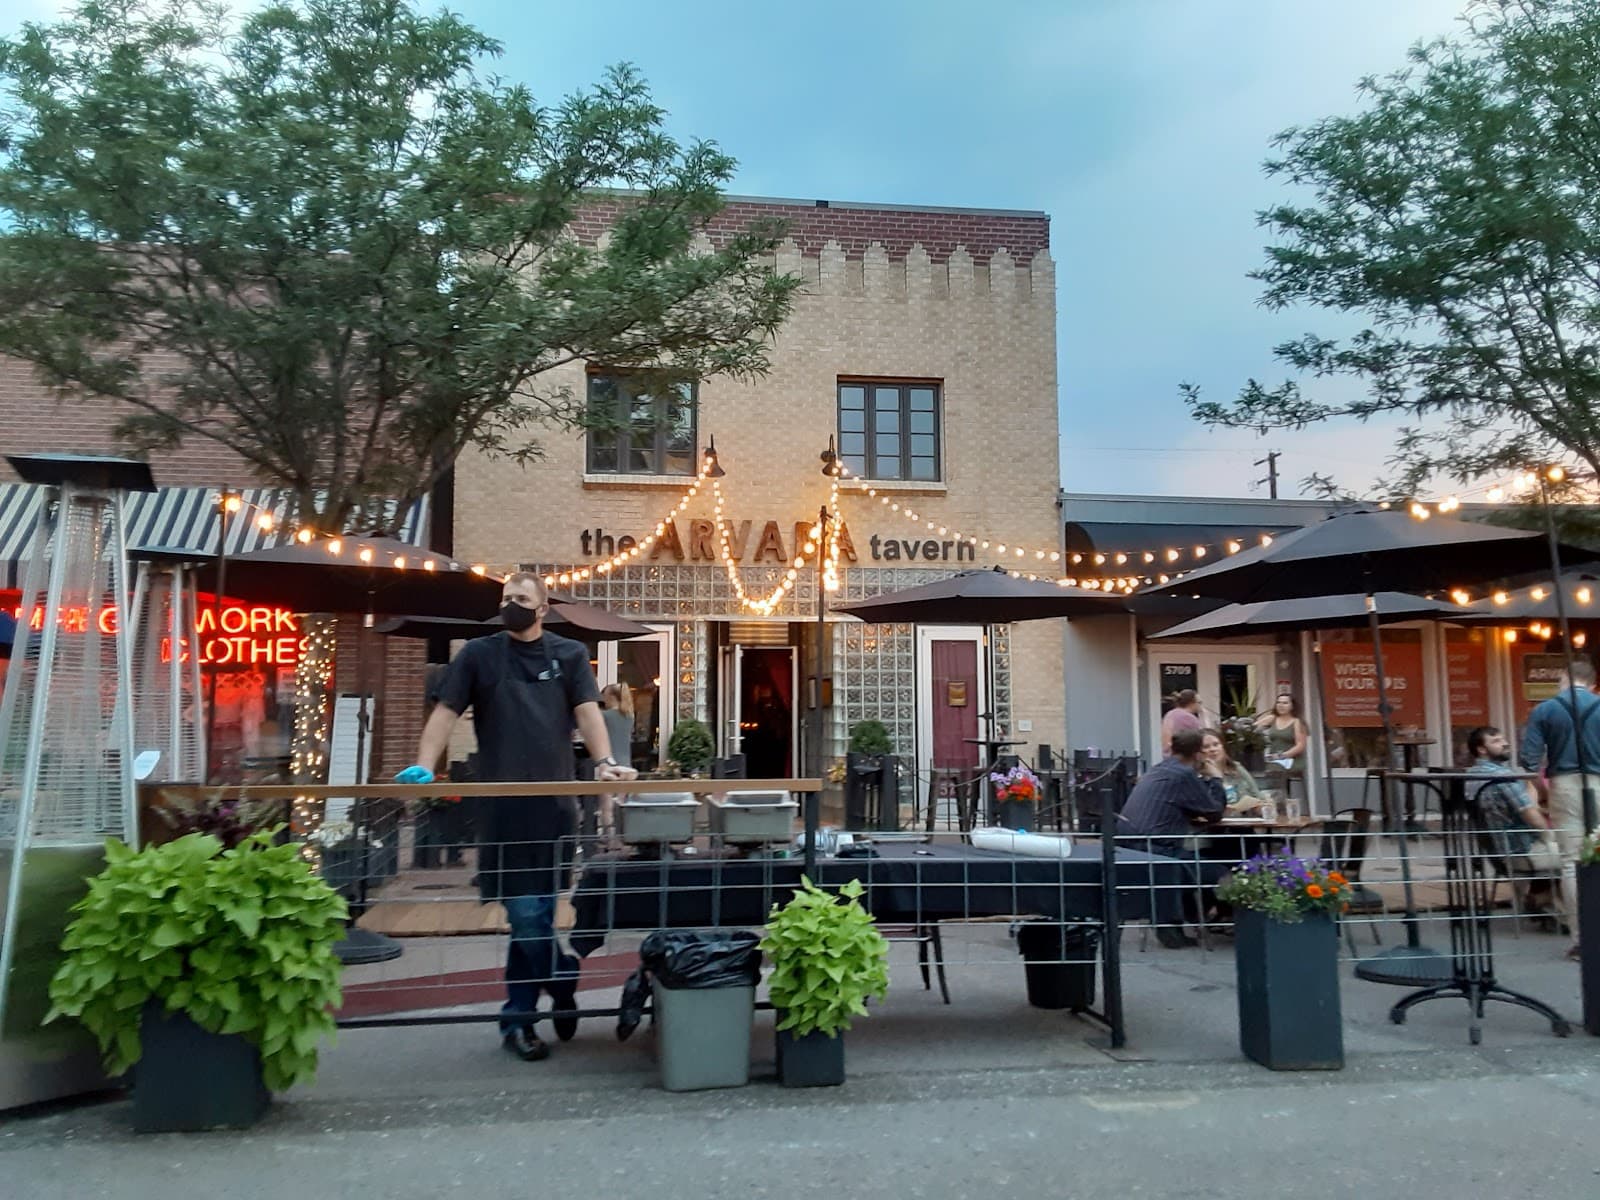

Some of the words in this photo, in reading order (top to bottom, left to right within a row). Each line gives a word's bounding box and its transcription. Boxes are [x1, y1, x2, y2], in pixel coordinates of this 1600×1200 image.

[581, 528, 636, 556] the
[869, 534, 975, 561] tavern
[1334, 663, 1381, 675] WHER
[1335, 677, 1376, 690] YOUR
